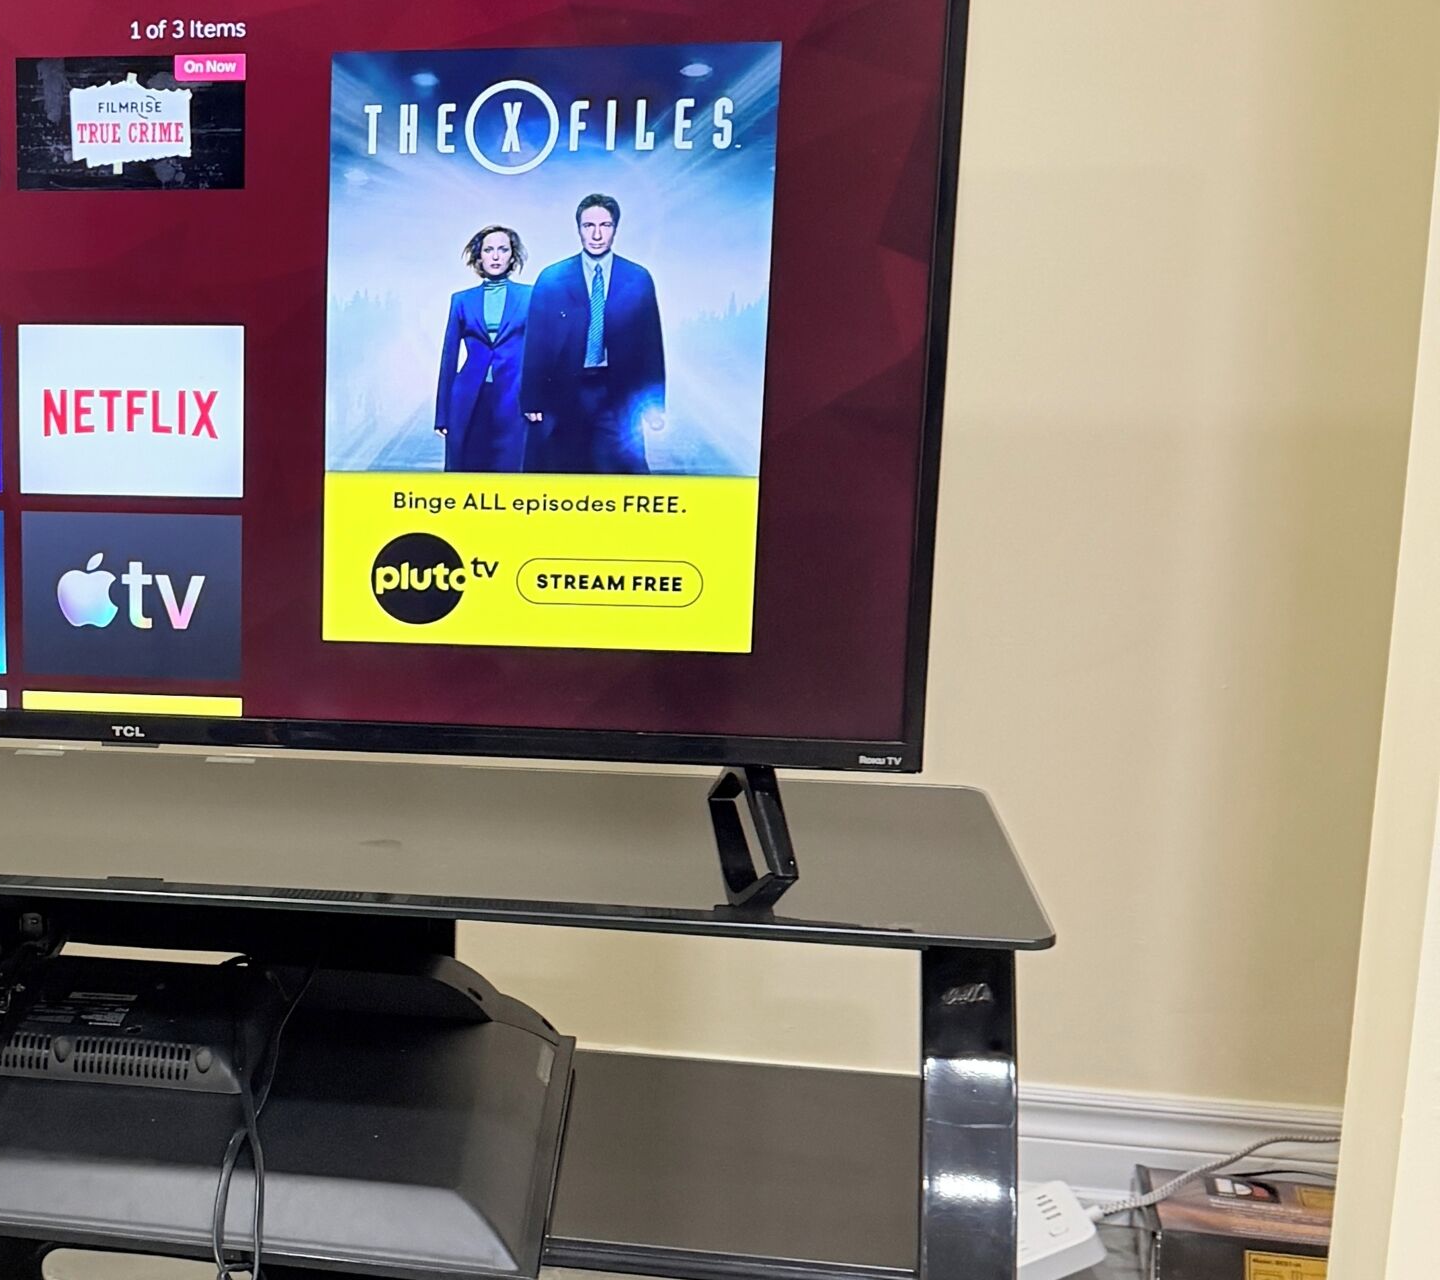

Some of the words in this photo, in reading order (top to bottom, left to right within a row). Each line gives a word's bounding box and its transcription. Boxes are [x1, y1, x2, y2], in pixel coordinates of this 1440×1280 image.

[130, 20, 140, 40] 1
[144, 19, 167, 39] of
[172, 18, 185, 38] 3
[189, 20, 246, 39] Items
[183, 60, 204, 74] On
[207, 59, 237, 74] Now
[97, 101, 162, 114] FILMRISE
[77, 123, 122, 144] TRUE
[128, 122, 184, 144] CRIME
[363, 103, 457, 154] THE
[501, 101, 521, 153] X
[568, 96, 733, 151] FILES
[43, 390, 219, 439] NETFLIX
[393, 492, 456, 513] Binge
[462, 494, 506, 511] ALL
[512, 494, 616, 515] episodes
[623, 496, 687, 514] FREE.
[470, 558, 498, 578] tv
[536, 574, 626, 591] STREAM
[632, 576, 683, 593] FREE
[121, 561, 207, 630] tv
[111, 726, 145, 737] TCL
[887, 756, 902, 766] TV
